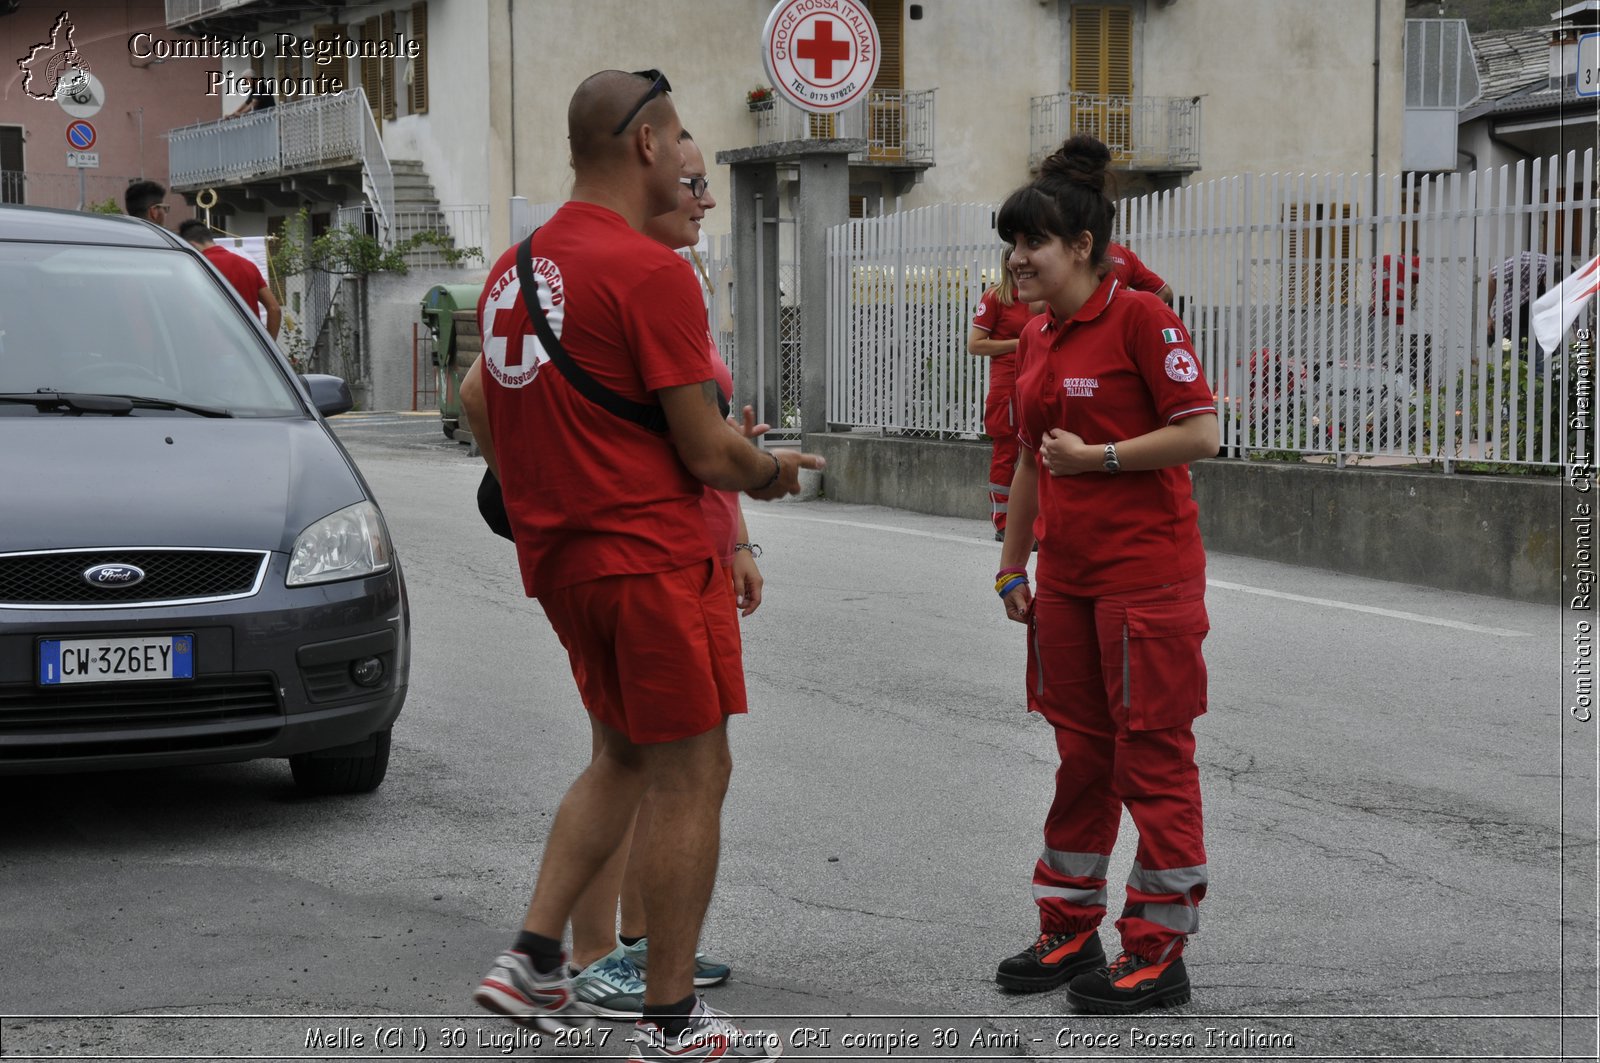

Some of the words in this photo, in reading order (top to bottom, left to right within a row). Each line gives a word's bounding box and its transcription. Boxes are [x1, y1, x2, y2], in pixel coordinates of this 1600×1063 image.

[776, 11, 797, 60] CROCE
[796, 0, 839, 15] ROSSA
[841, 5, 870, 63] ITALIANA
[791, 79, 807, 97] TEL.
[810, 91, 828, 101] 0175
[830, 82, 856, 101] 978222
[98, 568, 131, 582] Ford
